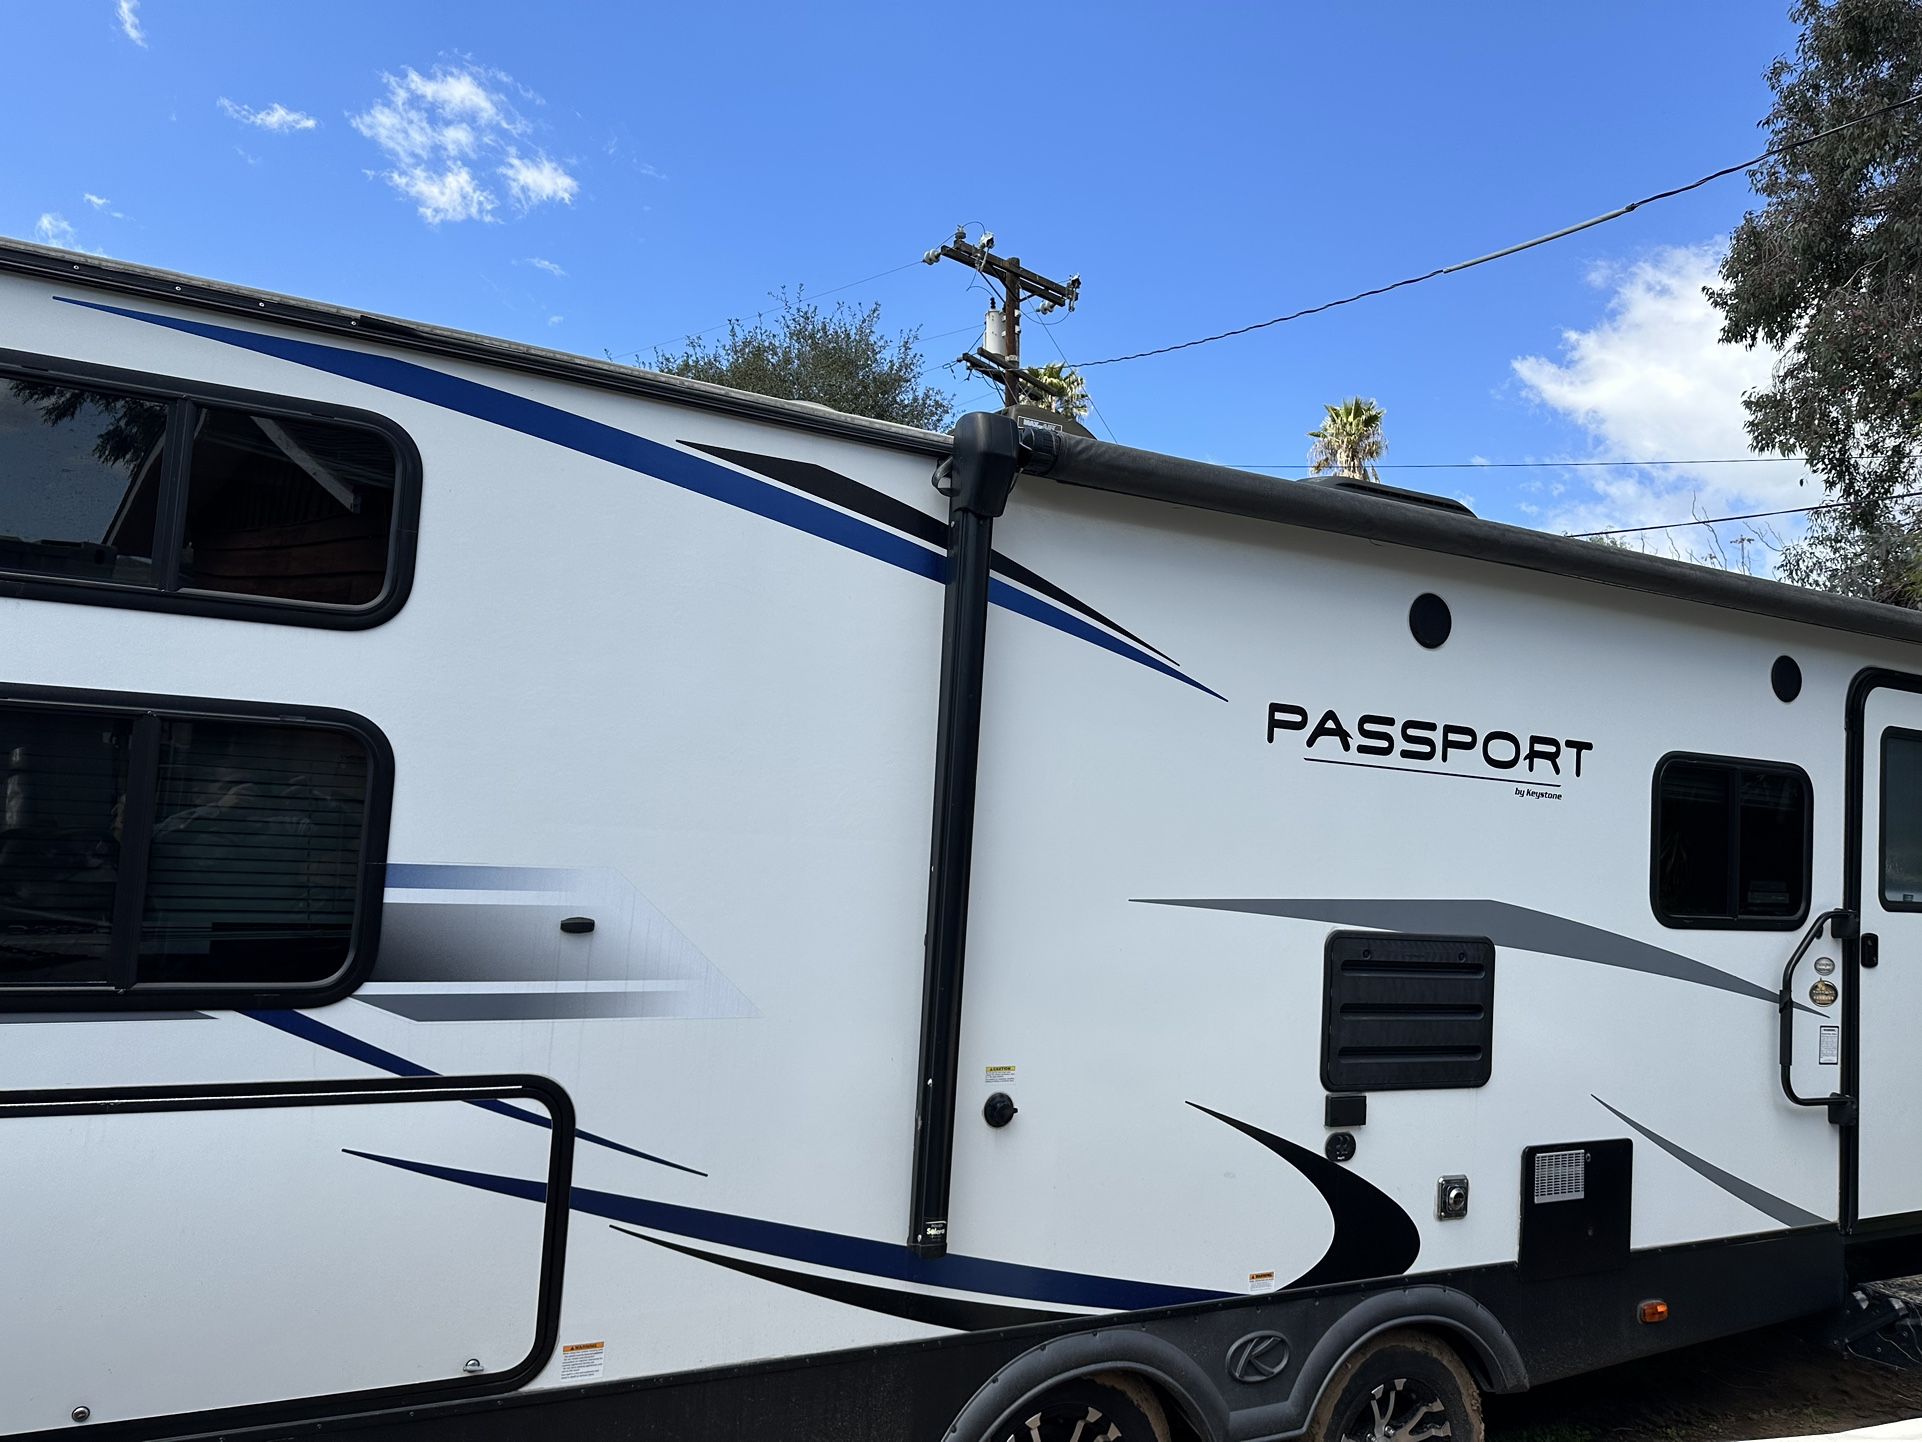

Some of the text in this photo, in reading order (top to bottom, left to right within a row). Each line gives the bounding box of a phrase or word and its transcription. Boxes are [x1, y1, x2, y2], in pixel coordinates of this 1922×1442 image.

[1266, 702, 1594, 778] PASSPORT
[1514, 787, 1562, 800] by Keystone
